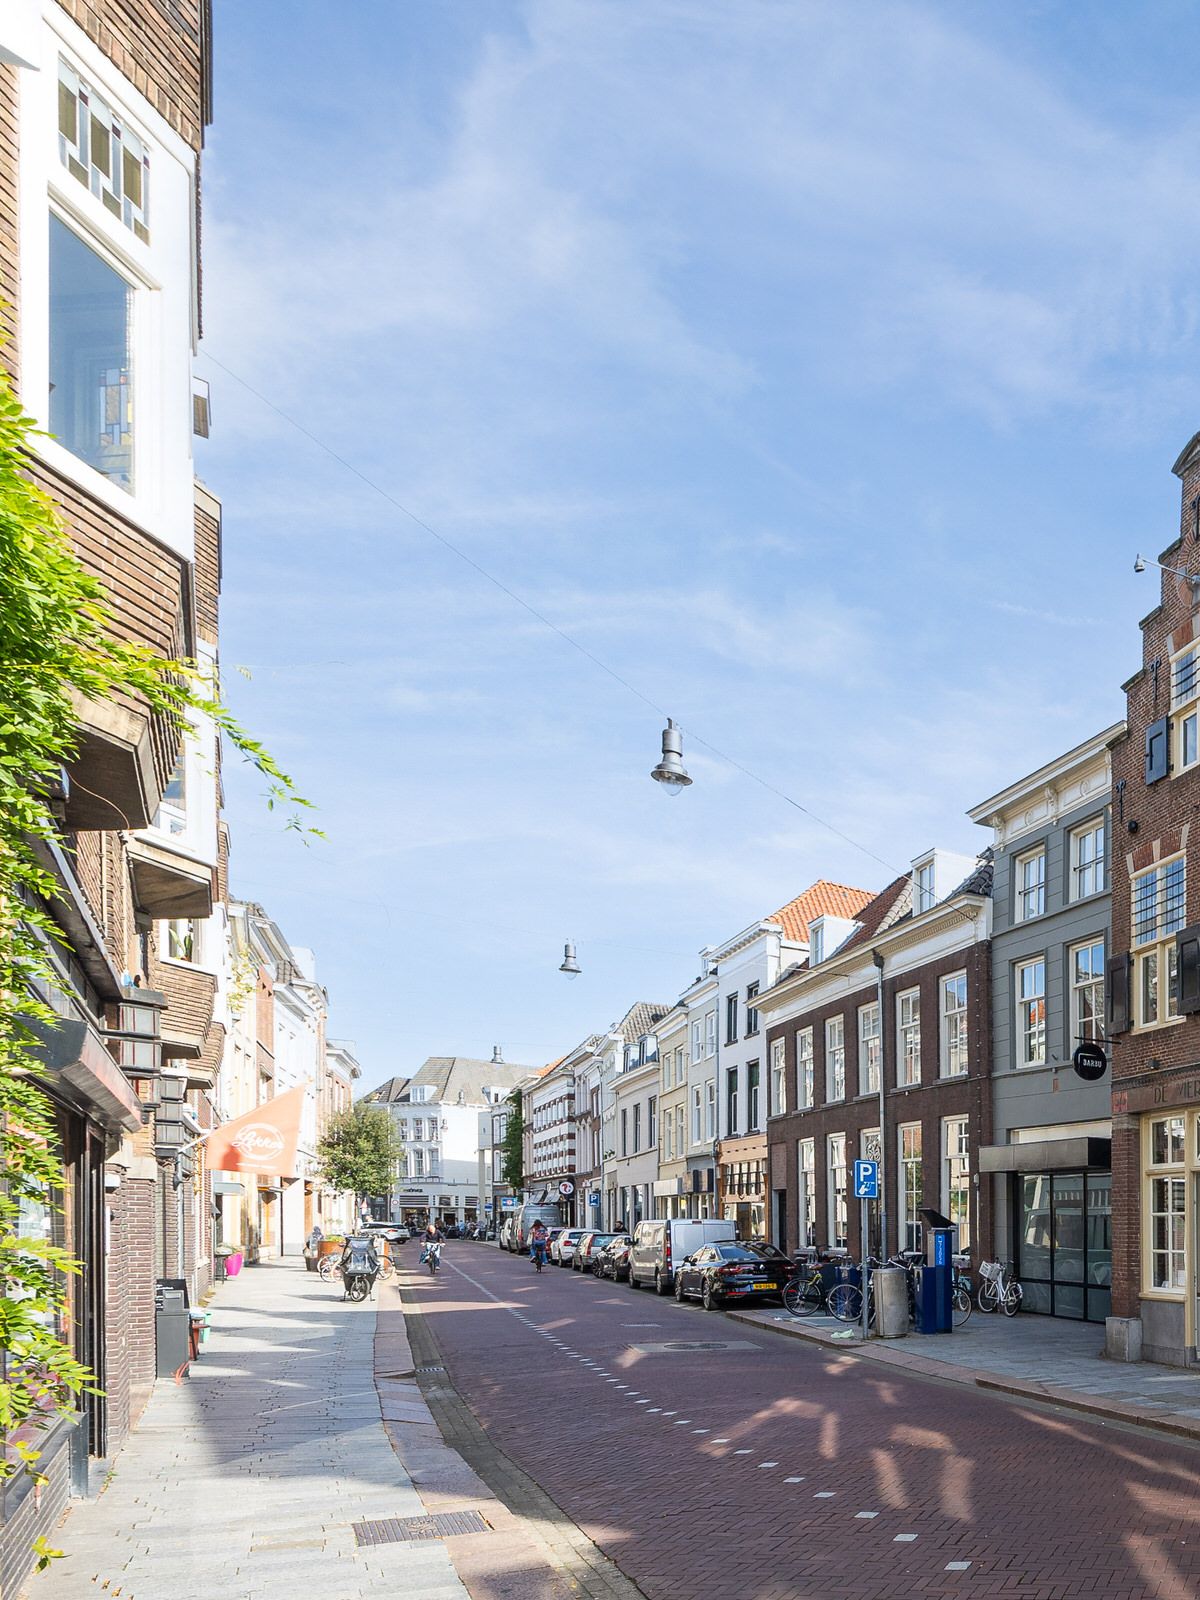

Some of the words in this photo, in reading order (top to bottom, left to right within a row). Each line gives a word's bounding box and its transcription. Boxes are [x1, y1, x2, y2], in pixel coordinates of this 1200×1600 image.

[1153, 1086, 1168, 1104] DE
[1179, 1080, 1200, 1099] VIER
[860, 1163, 873, 1182] P
